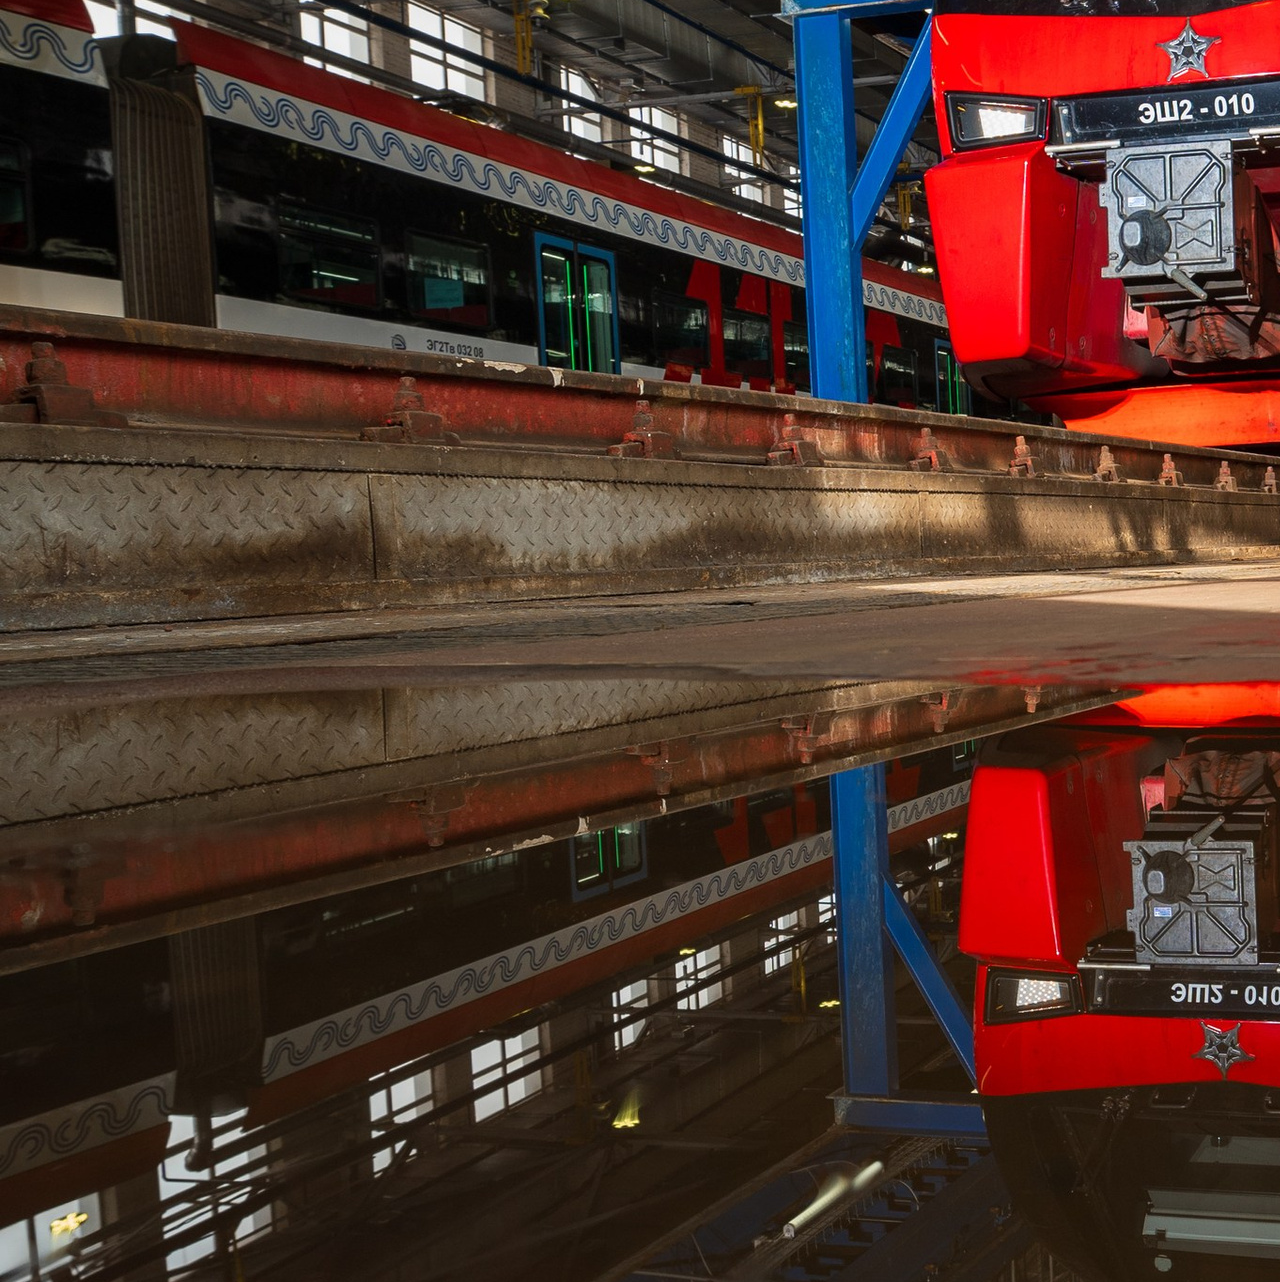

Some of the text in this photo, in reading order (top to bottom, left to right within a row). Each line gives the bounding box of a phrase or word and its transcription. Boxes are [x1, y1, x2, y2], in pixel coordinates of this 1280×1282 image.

[1138, 99, 1193, 124] ЭШ2
[1214, 93, 1255, 117] 010
[426, 339, 484, 358] ЭГ2Тв 032 08
